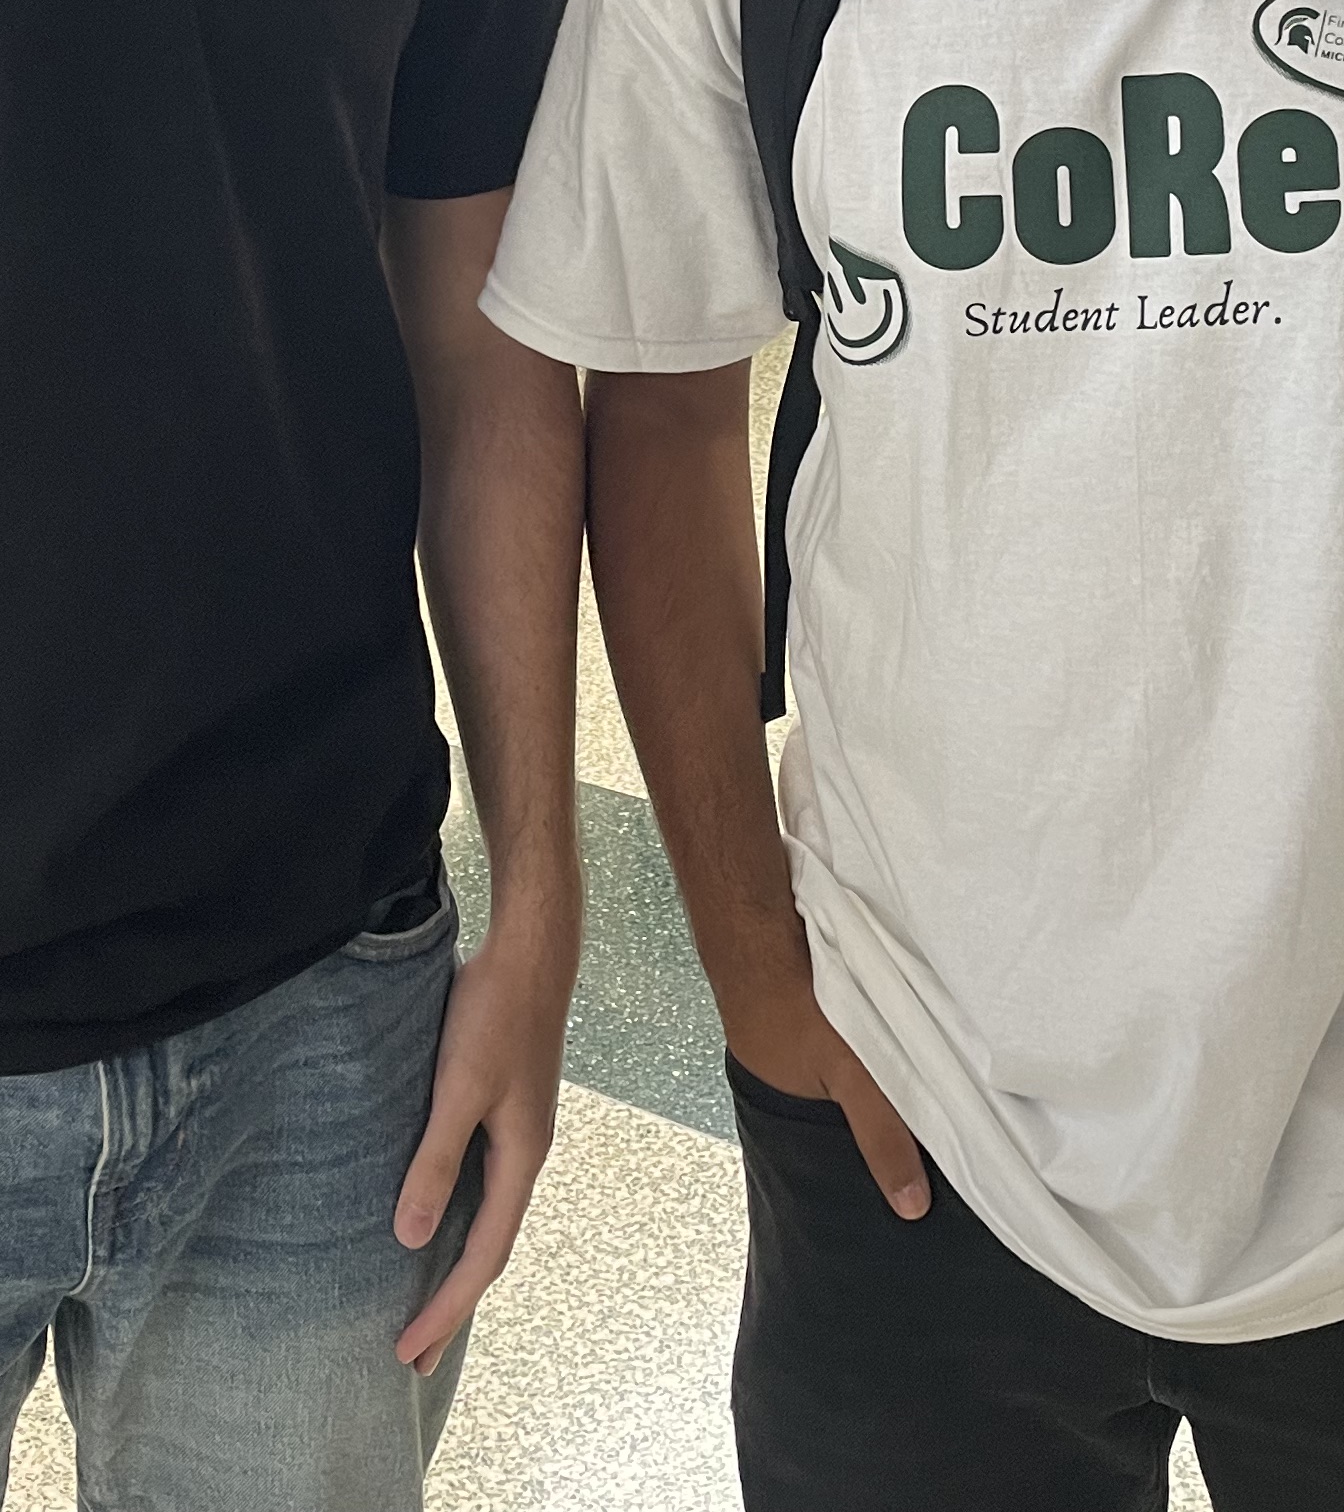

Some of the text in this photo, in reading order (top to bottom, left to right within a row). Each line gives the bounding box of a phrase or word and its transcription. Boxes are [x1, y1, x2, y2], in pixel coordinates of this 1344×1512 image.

[902, 73, 1341, 271] CoRe
[965, 280, 1282, 337] Student Leader.
